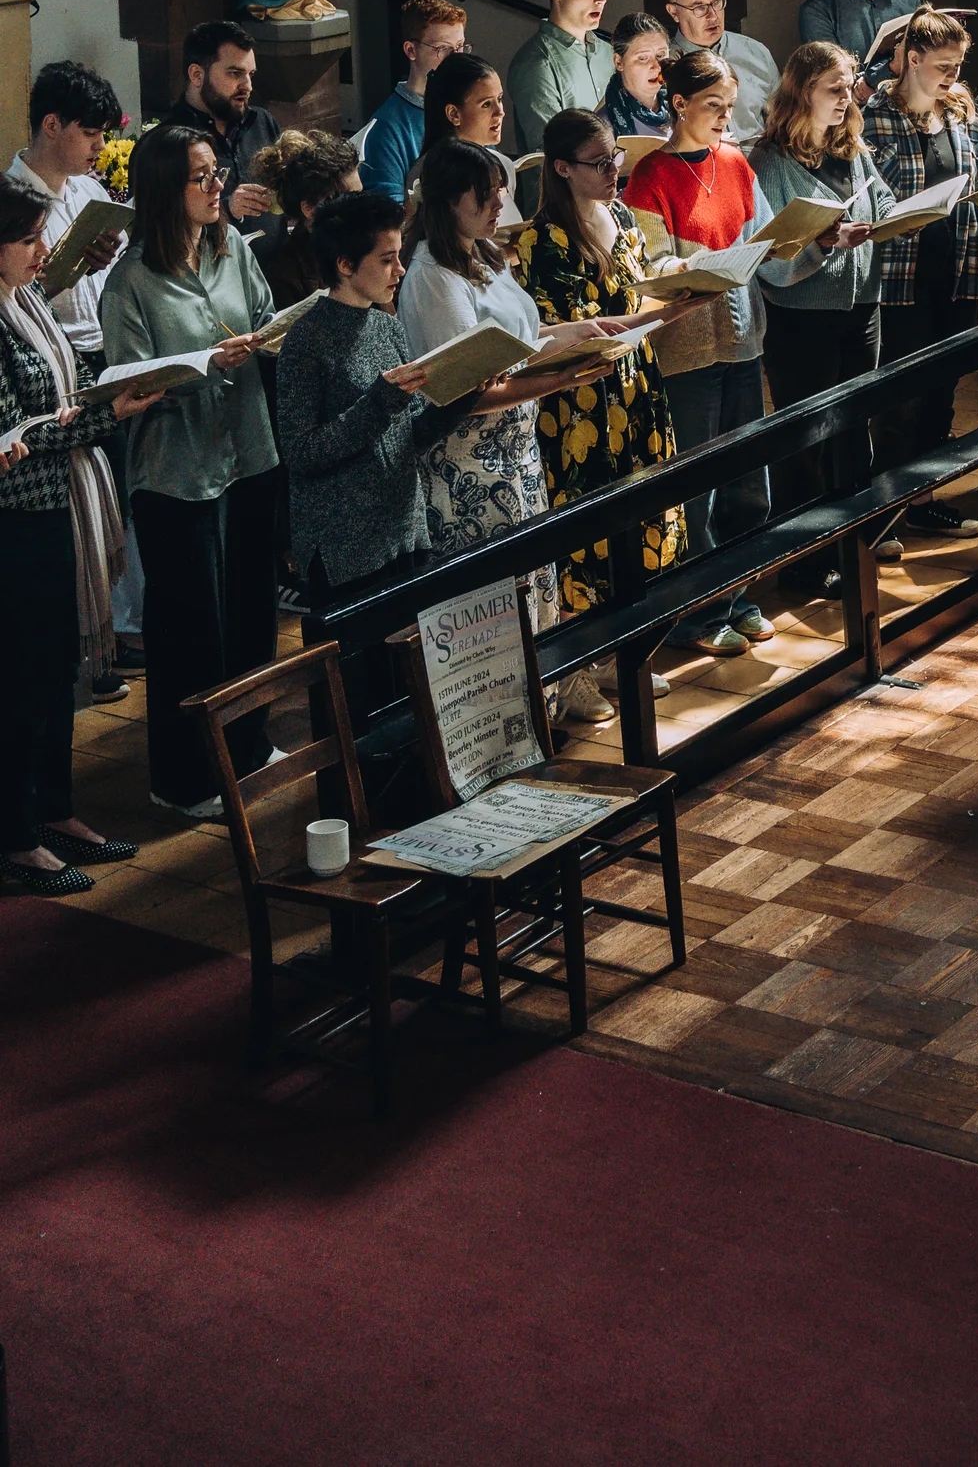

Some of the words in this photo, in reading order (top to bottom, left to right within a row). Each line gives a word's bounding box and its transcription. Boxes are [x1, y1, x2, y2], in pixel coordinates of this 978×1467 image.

[426, 625, 435, 646] A
[438, 593, 515, 644] SUMMER
[436, 626, 501, 664] SERENADE
[448, 658, 466, 670] Directed
[466, 654, 472, 662] by
[472, 650, 484, 659] Chris
[438, 686, 453, 700] 15TH
[454, 676, 472, 694] JUNE
[472, 669, 490, 683] 2024
[440, 693, 466, 714] Liverpool
[467, 684, 488, 700] Parish
[489, 672, 516, 689] Church
[442, 716, 450, 727] L2
[450, 709, 462, 723] 8TZ
[446, 728, 463, 746] 22ND
[464, 719, 482, 738] JUNE
[483, 712, 501, 726] 2024
[448, 740, 472, 760] Beverley
[473, 727, 499, 746] Minster
[450, 757, 467, 774] HU17
[461, 783, 474, 800] THE
[473, 772, 490, 790] TALLIS
[490, 752, 542, 778] CONSORT
[452, 814, 480, 824] Church
[384, 836, 474, 858] SUMMER
